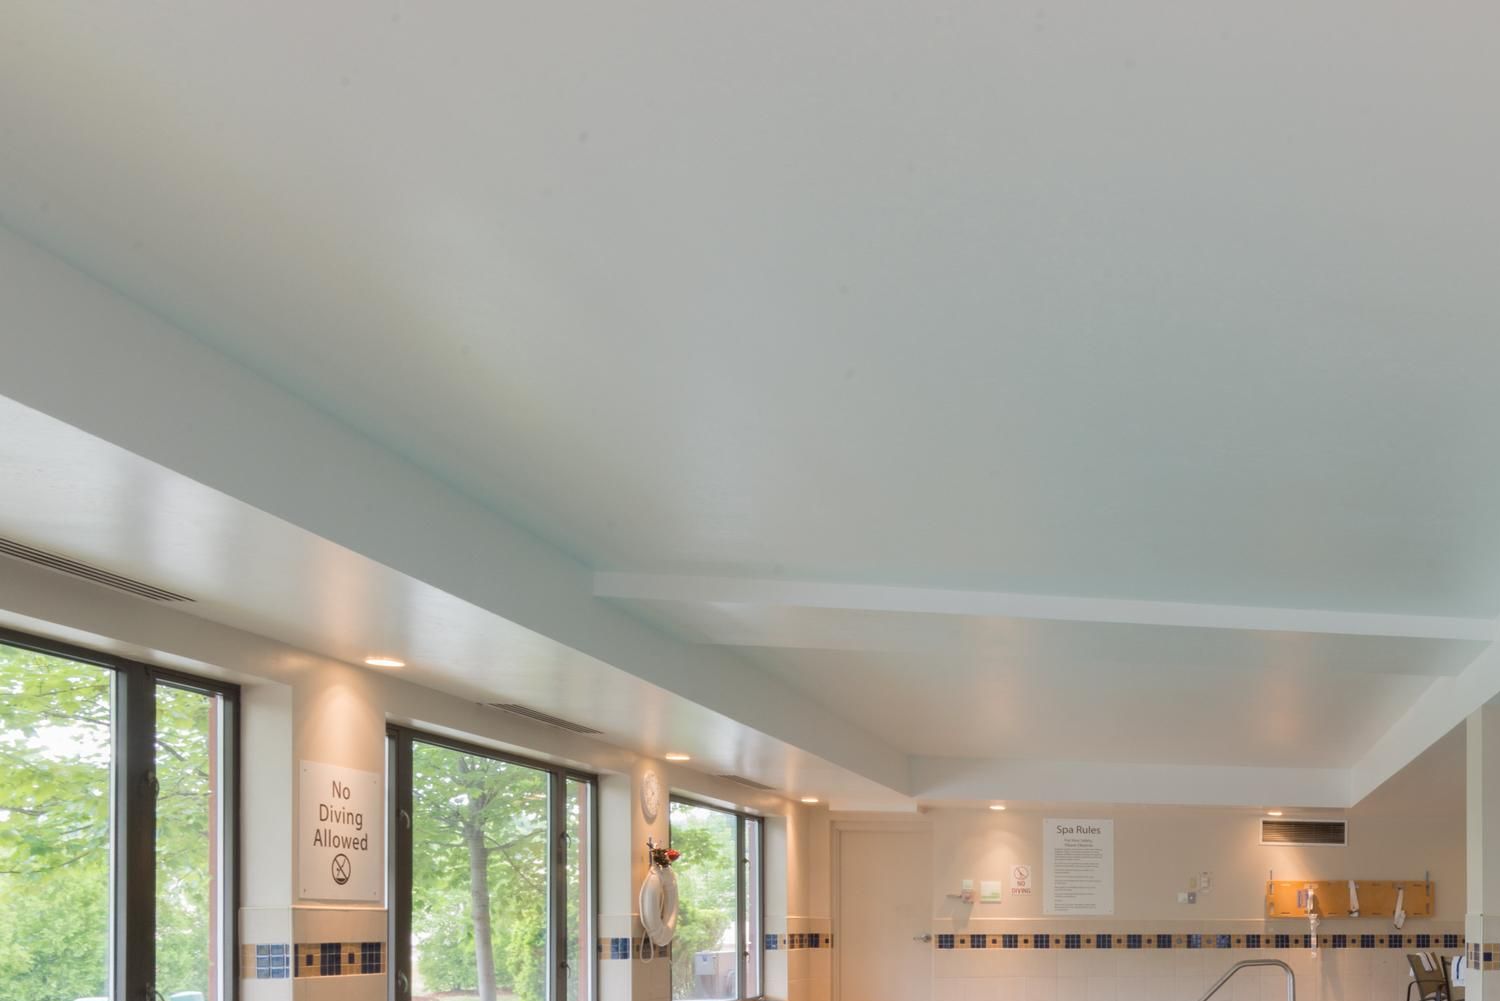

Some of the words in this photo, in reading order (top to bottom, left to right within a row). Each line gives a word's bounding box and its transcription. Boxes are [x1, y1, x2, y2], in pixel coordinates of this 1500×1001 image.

[332, 780, 351, 800] No
[319, 803, 364, 831] Diving
[313, 828, 368, 851] Allowed
[1056, 824, 1074, 836] Spa
[1076, 824, 1101, 835] Rules
